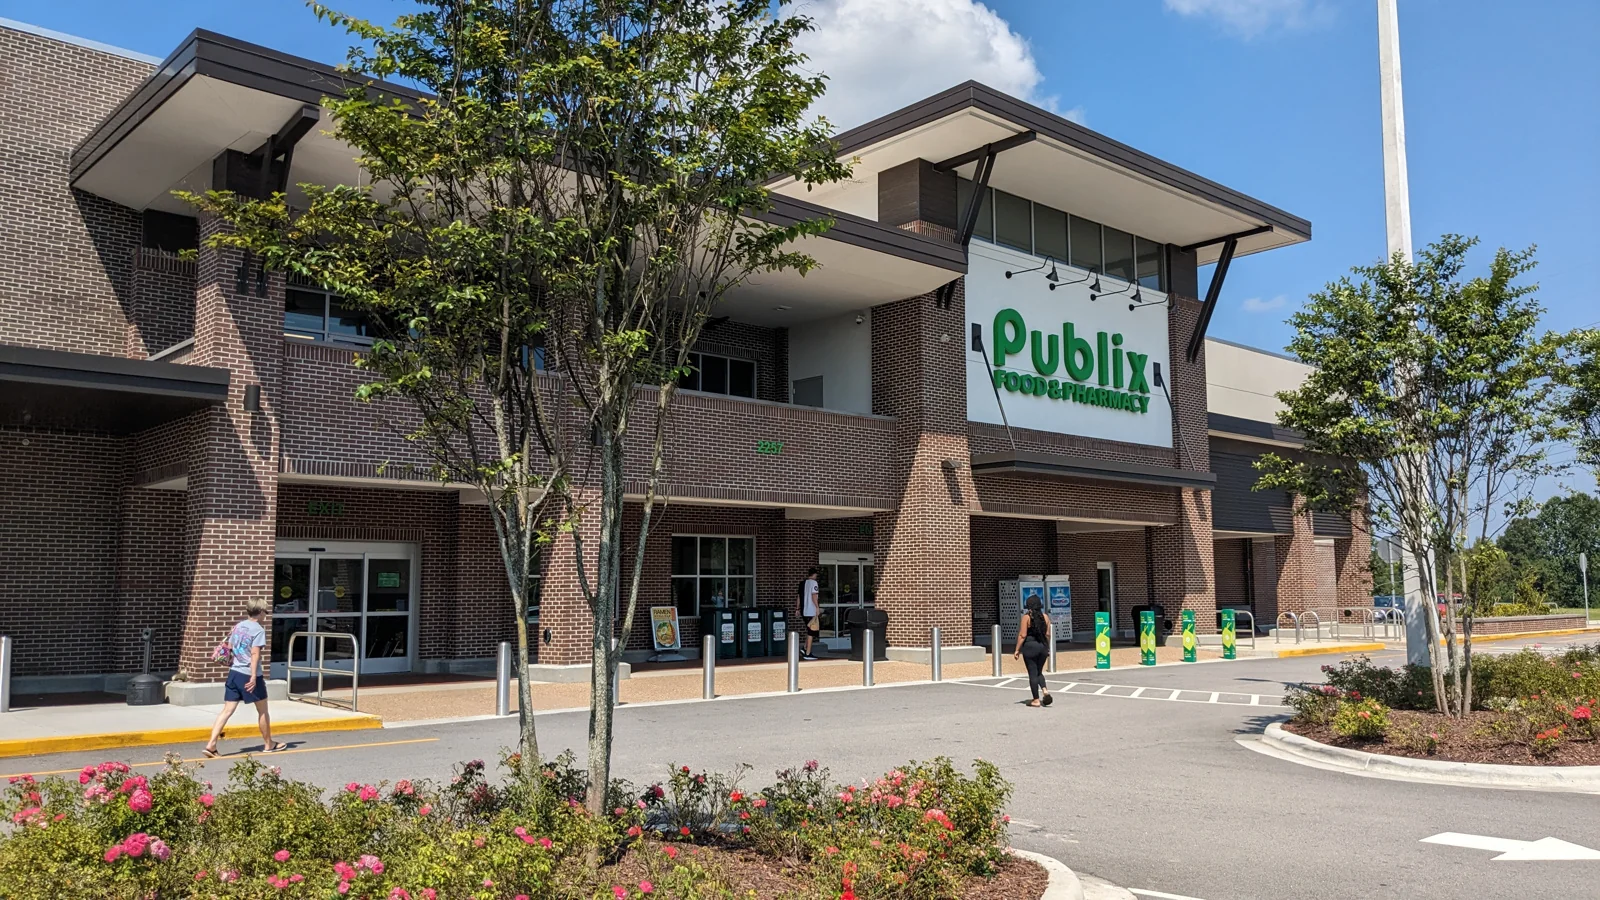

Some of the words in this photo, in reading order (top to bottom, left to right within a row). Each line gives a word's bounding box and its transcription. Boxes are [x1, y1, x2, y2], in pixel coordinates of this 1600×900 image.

[993, 308, 1150, 393] Publix
[757, 440, 784, 454] 2257
[308, 502, 344, 516] EXIT
